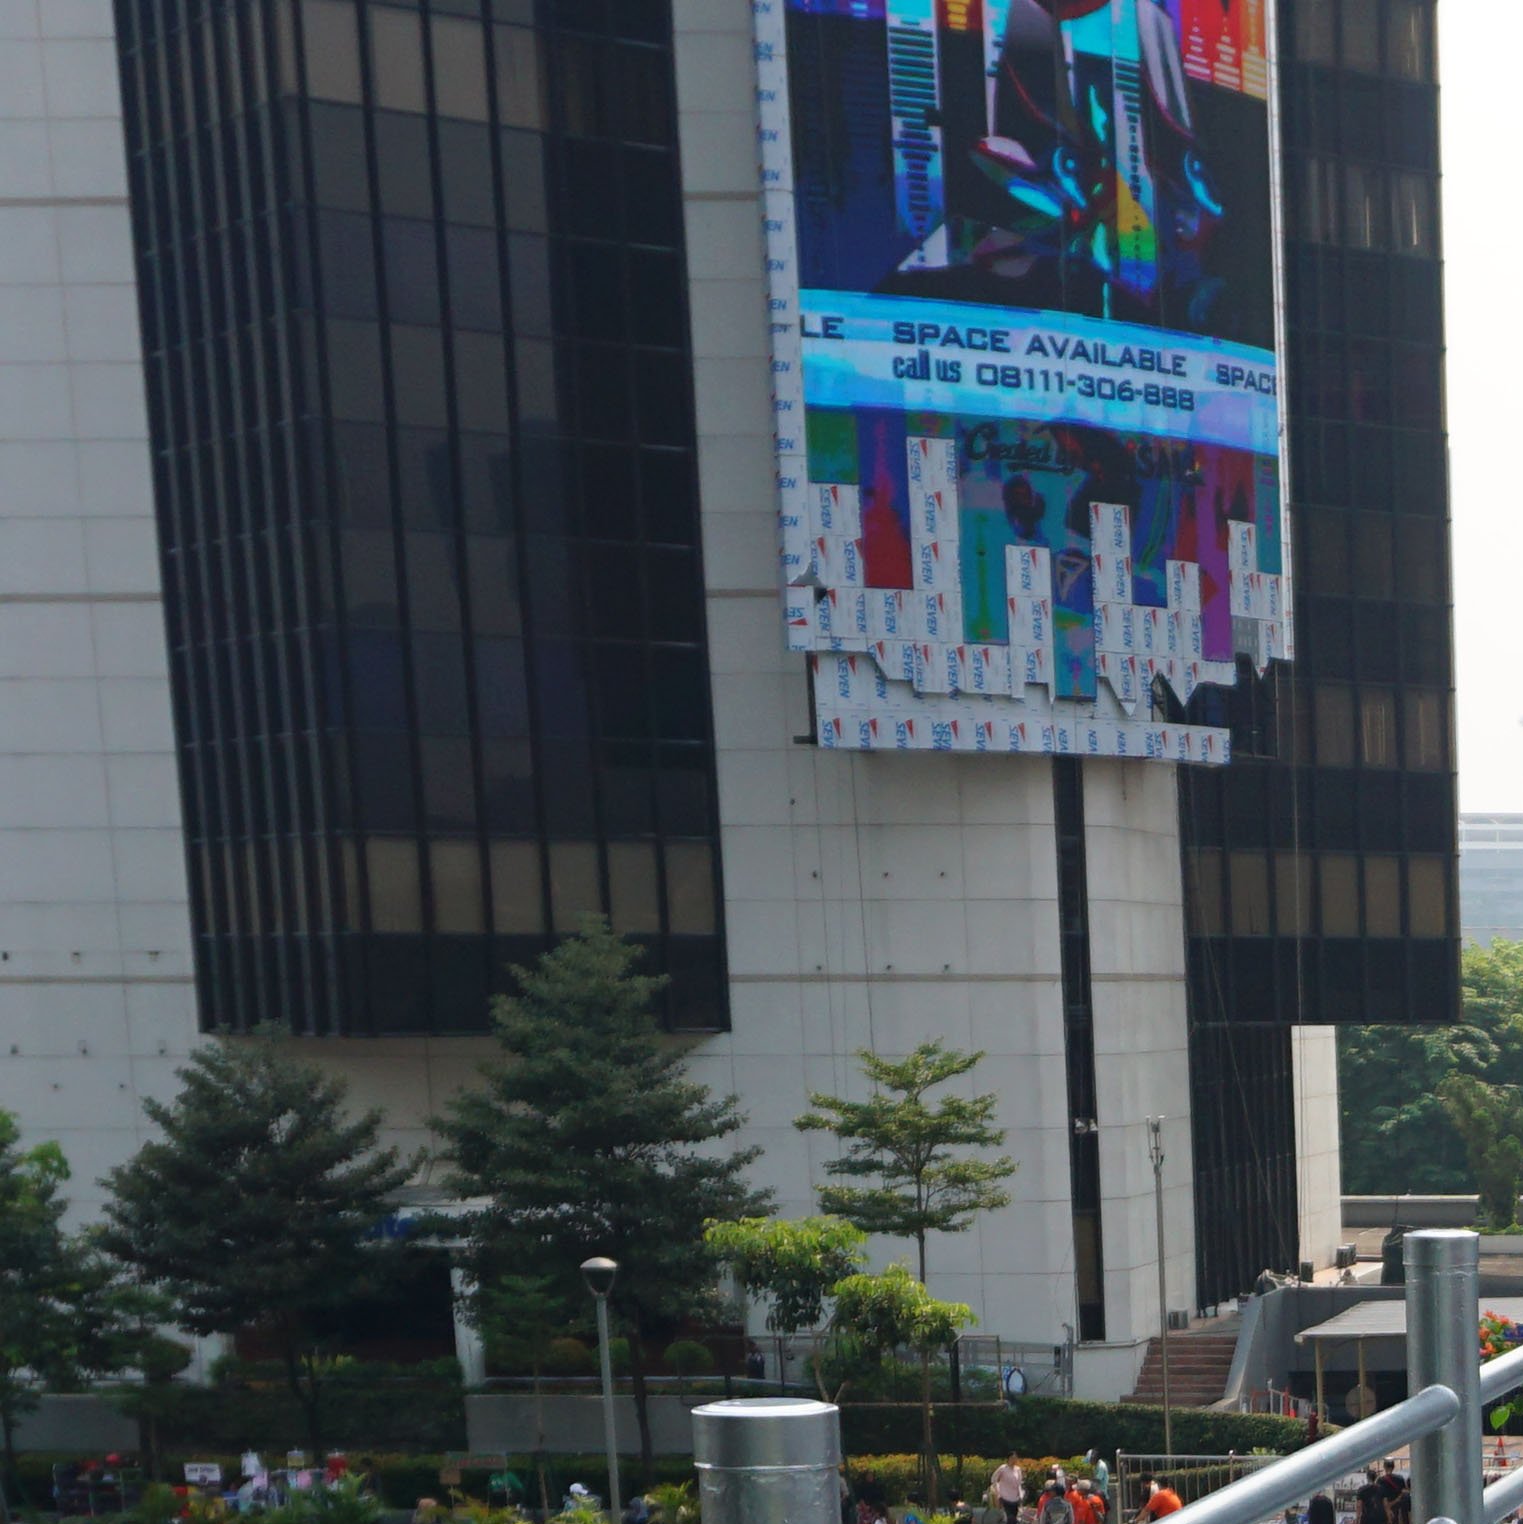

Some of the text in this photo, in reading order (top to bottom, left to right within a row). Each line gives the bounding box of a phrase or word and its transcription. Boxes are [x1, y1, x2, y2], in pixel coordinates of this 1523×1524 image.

[893, 321, 1011, 354] SPACE
[1025, 333, 1188, 378] AVAILABLE
[1216, 363, 1277, 396] SPAC
[892, 349, 1195, 411] call us 08111-306-888
[910, 442, 921, 482] SEVEN
[925, 493, 936, 533] SEVEN
[1113, 508, 1124, 548] SEVEN
[844, 541, 856, 581] SEVEN
[921, 544, 933, 584] SEVEN
[1020, 551, 1031, 591] SEVEN
[1115, 559, 1125, 597] SEVEN
[884, 593, 896, 633] SEVEN
[926, 595, 937, 635] SEVEN
[1032, 601, 1043, 641] SEVEN
[1122, 608, 1133, 648] SEVEN
[1144, 610, 1153, 649] SEVEN
[838, 658, 850, 698] SEVEN
[973, 650, 984, 689] SEVEN
